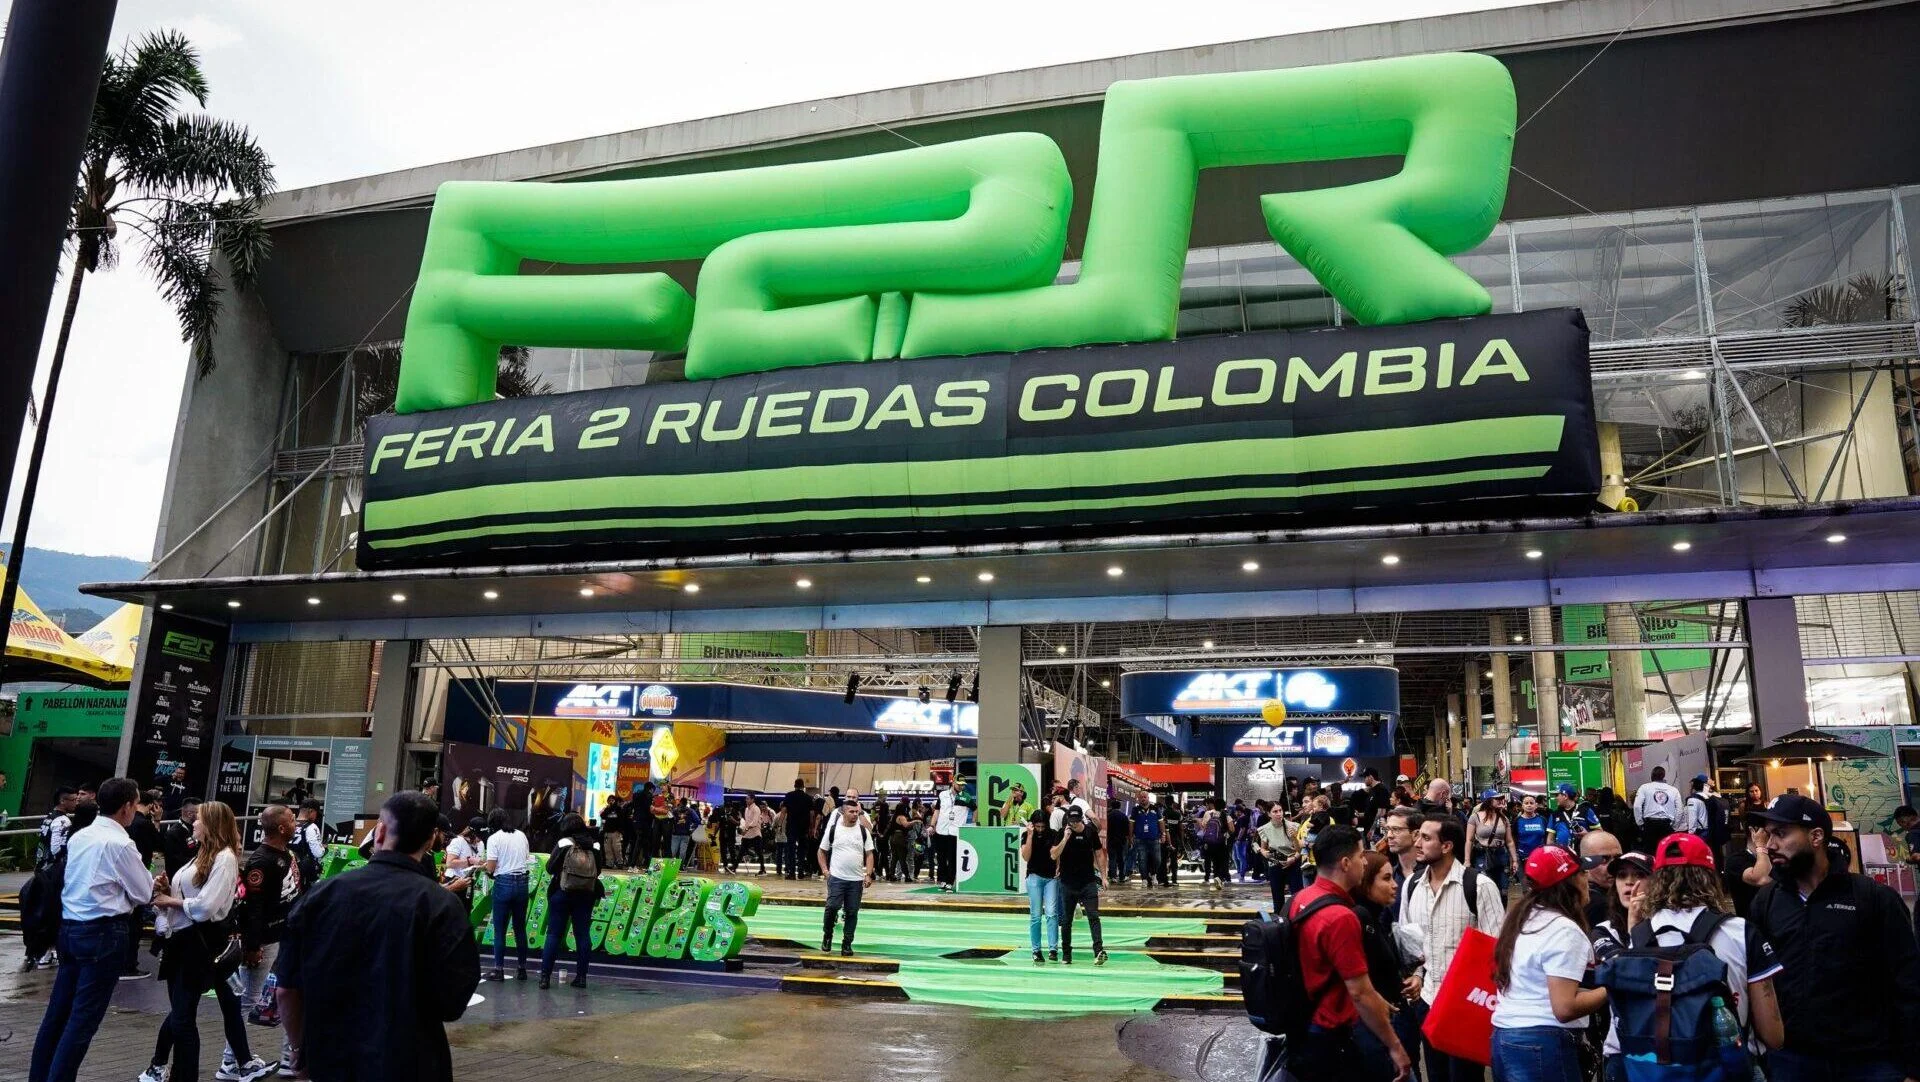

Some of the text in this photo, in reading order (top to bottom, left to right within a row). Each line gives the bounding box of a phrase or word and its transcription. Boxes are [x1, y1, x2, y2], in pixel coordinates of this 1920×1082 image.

[396, 52, 1517, 414] F2R
[369, 338, 1531, 475] FERIA 2 RUEDAS COLOMBIA
[164, 631, 214, 655] F2R
[1570, 664, 1602, 676] F2R
[1174, 673, 1272, 701] AKT
[557, 685, 632, 707] AKT
[86, 697, 127, 709] NARANJA
[1235, 727, 1304, 746] AKT
[623, 748, 649, 757] AKT
[496, 766, 531, 777] SHAFT
[225, 777, 244, 785] ENJOY
[512, 775, 529, 783] PRO
[874, 780, 936, 790] VENTO
[220, 785, 233, 793] THE
[1004, 832, 1019, 892] F2R
[1833, 903, 1856, 911] TERREX
